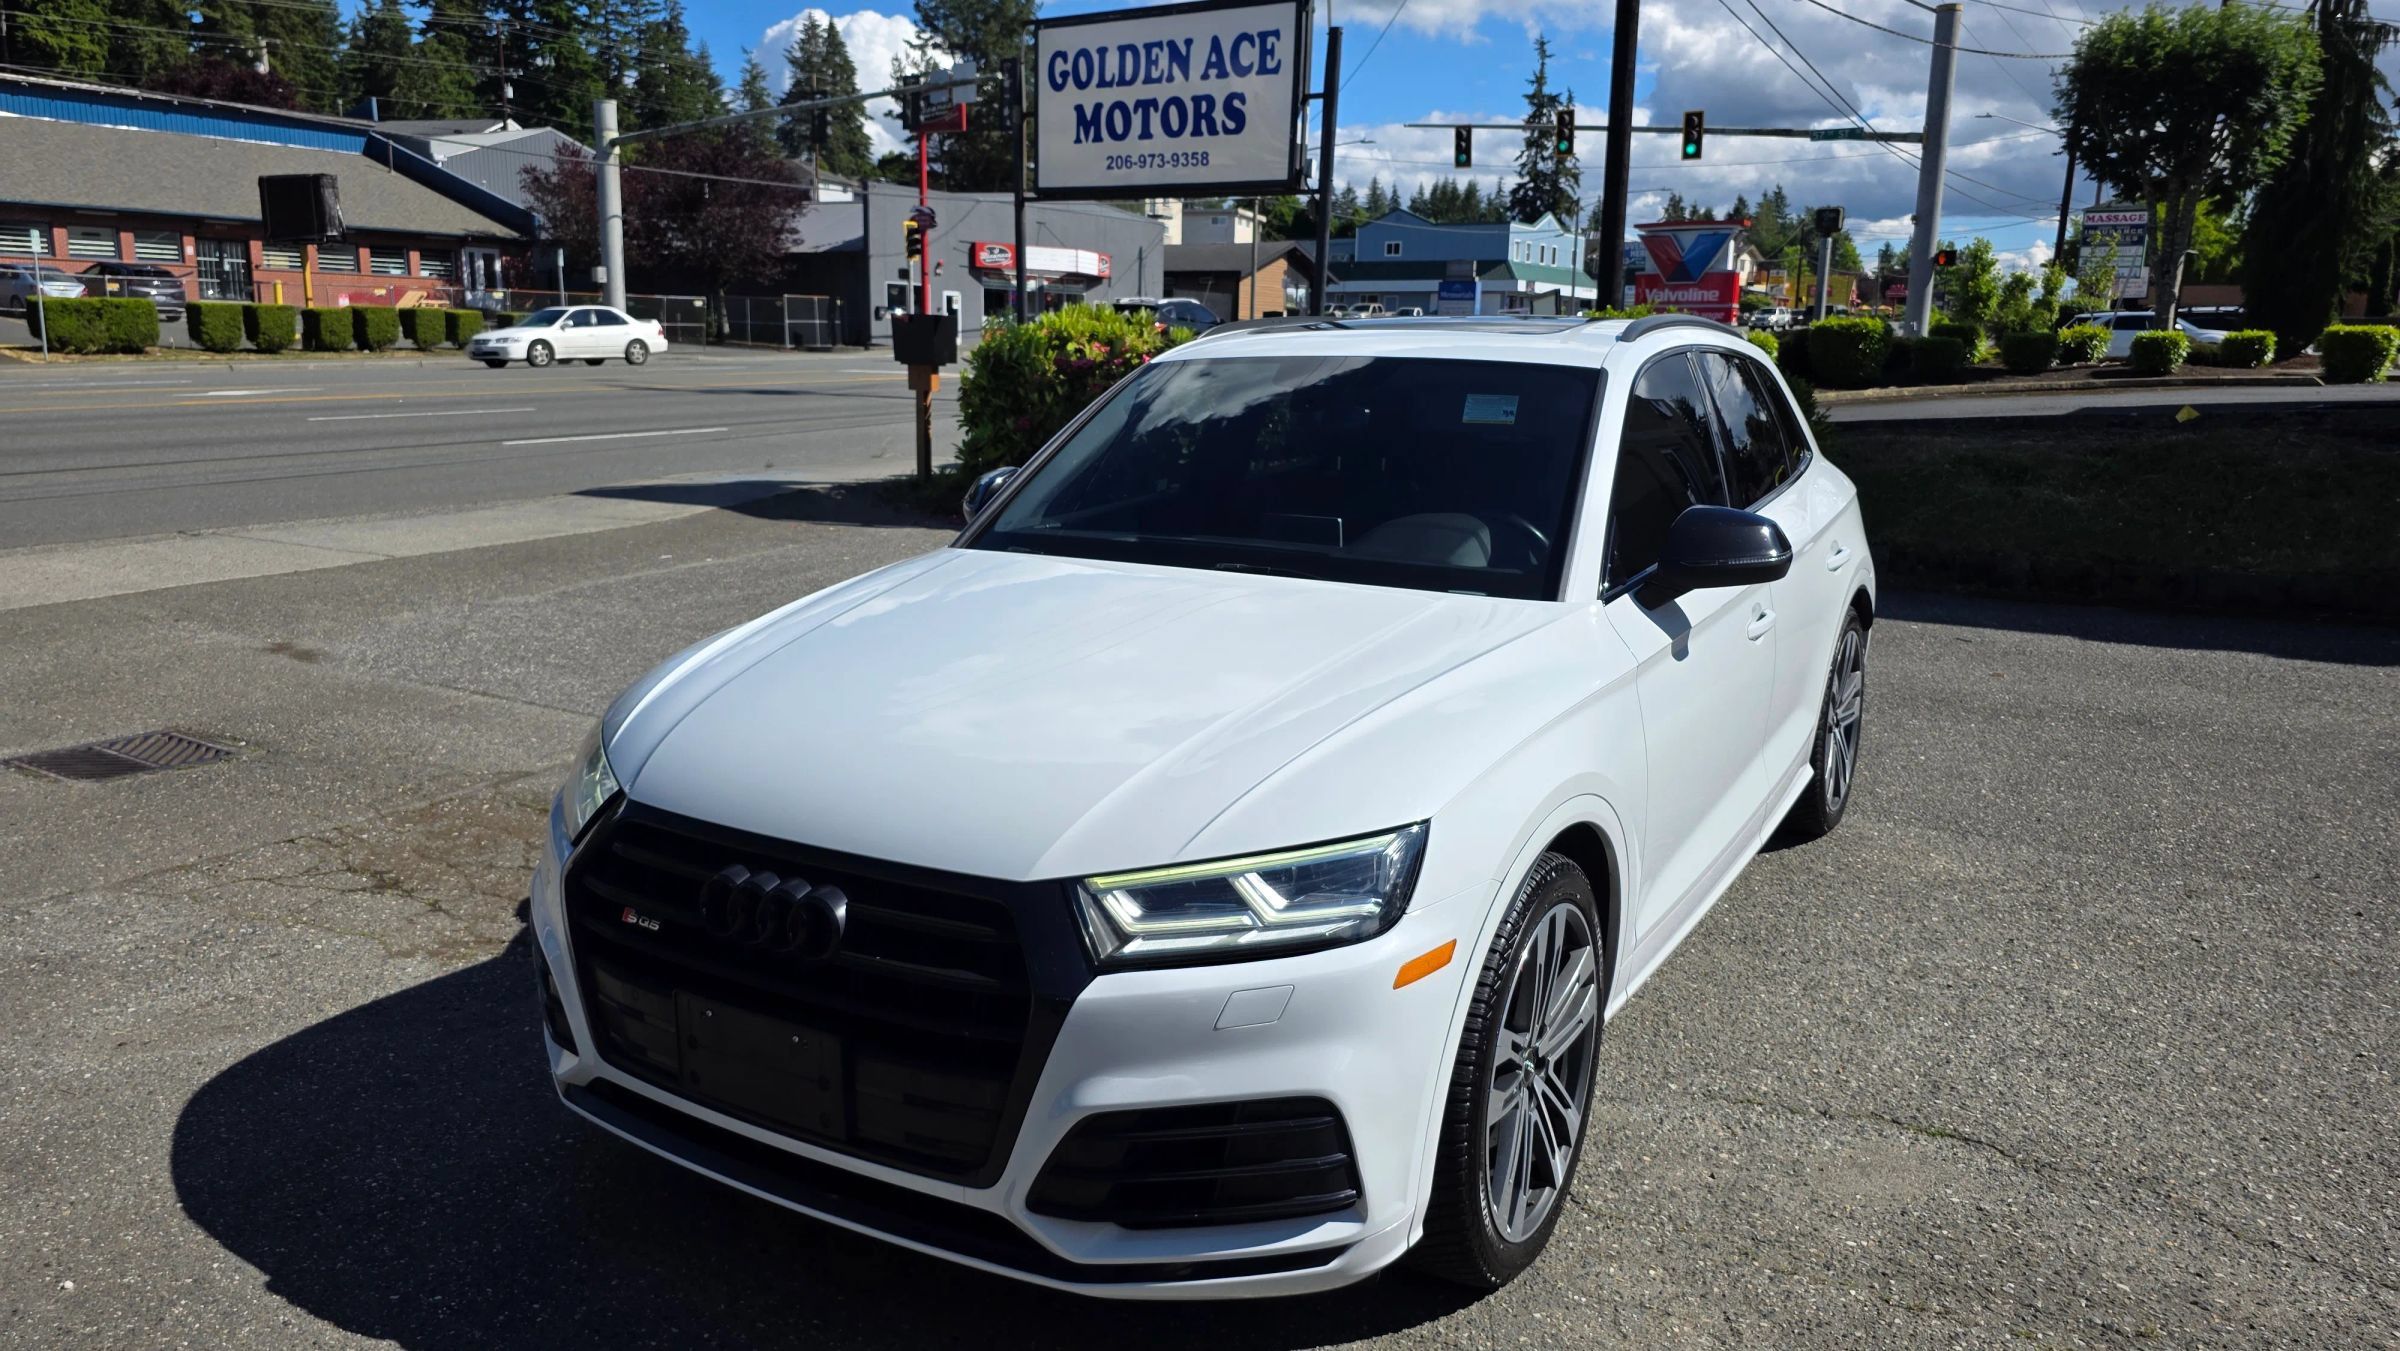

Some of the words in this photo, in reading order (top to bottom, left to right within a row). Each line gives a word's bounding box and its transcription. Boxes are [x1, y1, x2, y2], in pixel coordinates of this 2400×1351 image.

[1047, 37, 1194, 92] GOLDEN
[1200, 28, 1282, 81] ACE
[1073, 91, 1247, 145] MOTORS
[1106, 151, 1210, 171] 206-973-9358
[2086, 213, 2146, 223] MASSAGE
[1645, 288, 1720, 302] Valvoline
